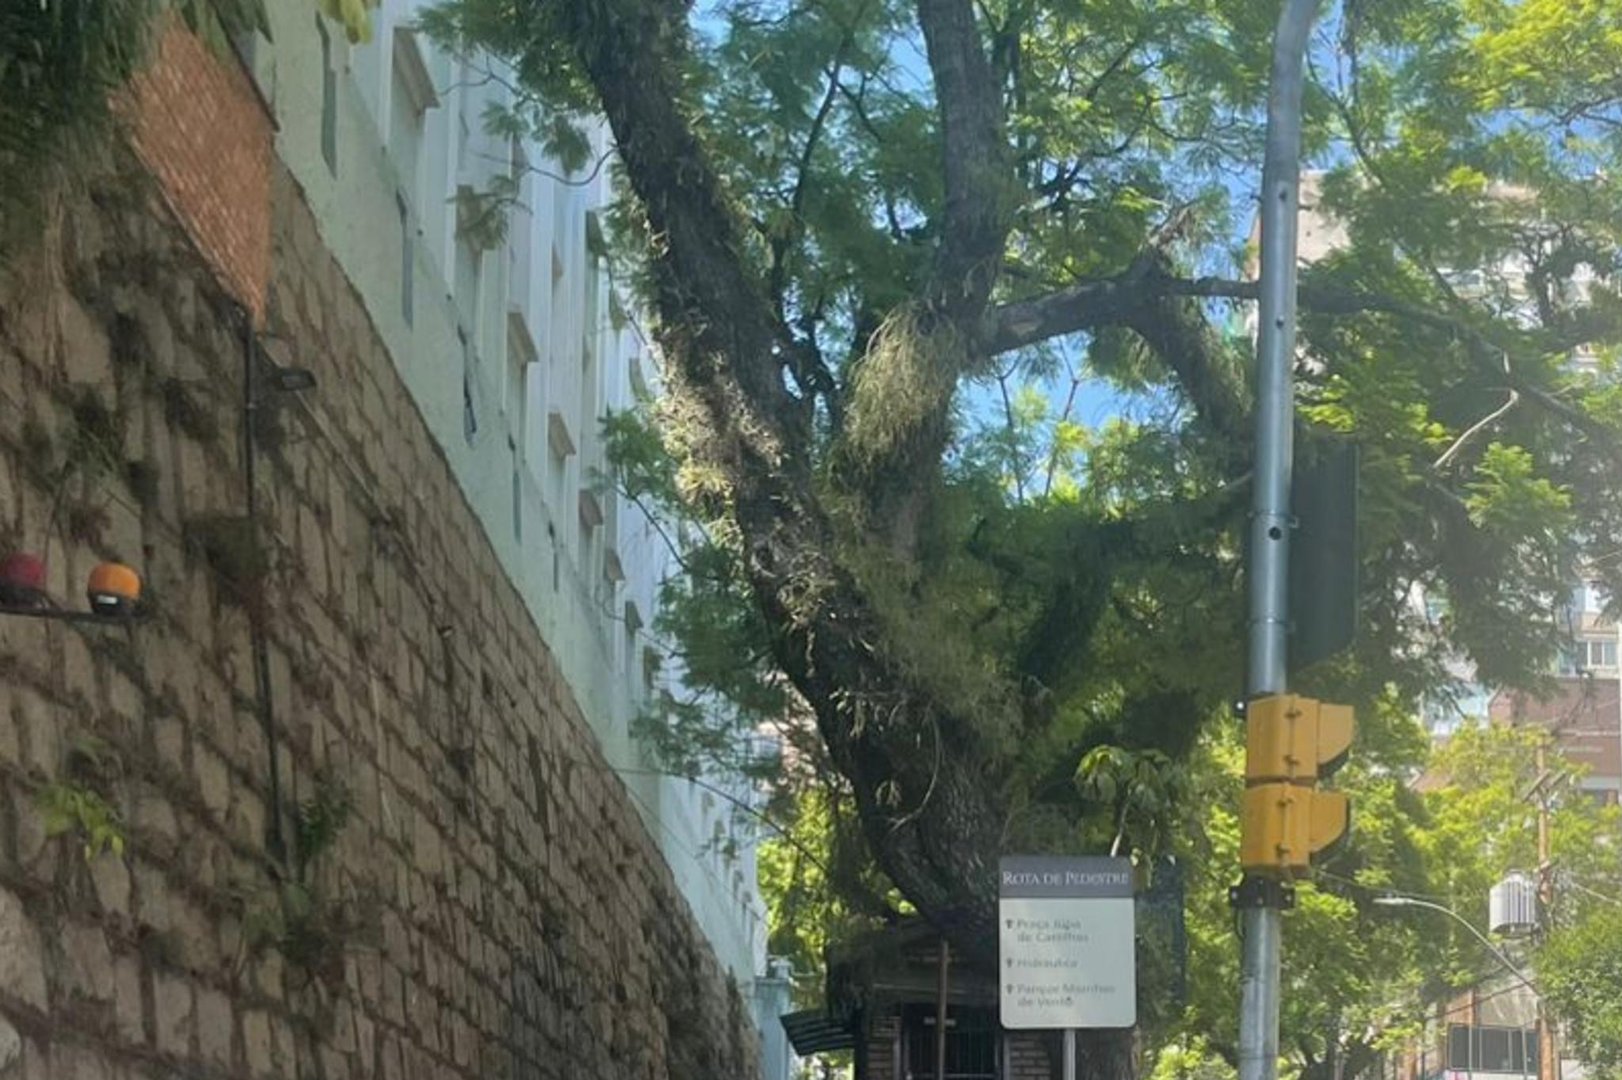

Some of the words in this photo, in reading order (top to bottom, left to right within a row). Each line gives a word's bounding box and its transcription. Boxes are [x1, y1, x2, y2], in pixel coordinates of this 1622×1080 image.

[1002, 870, 1040, 886] ROTA
[1043, 872, 1062, 886] DE
[1065, 870, 1129, 886] PEDESTRE
